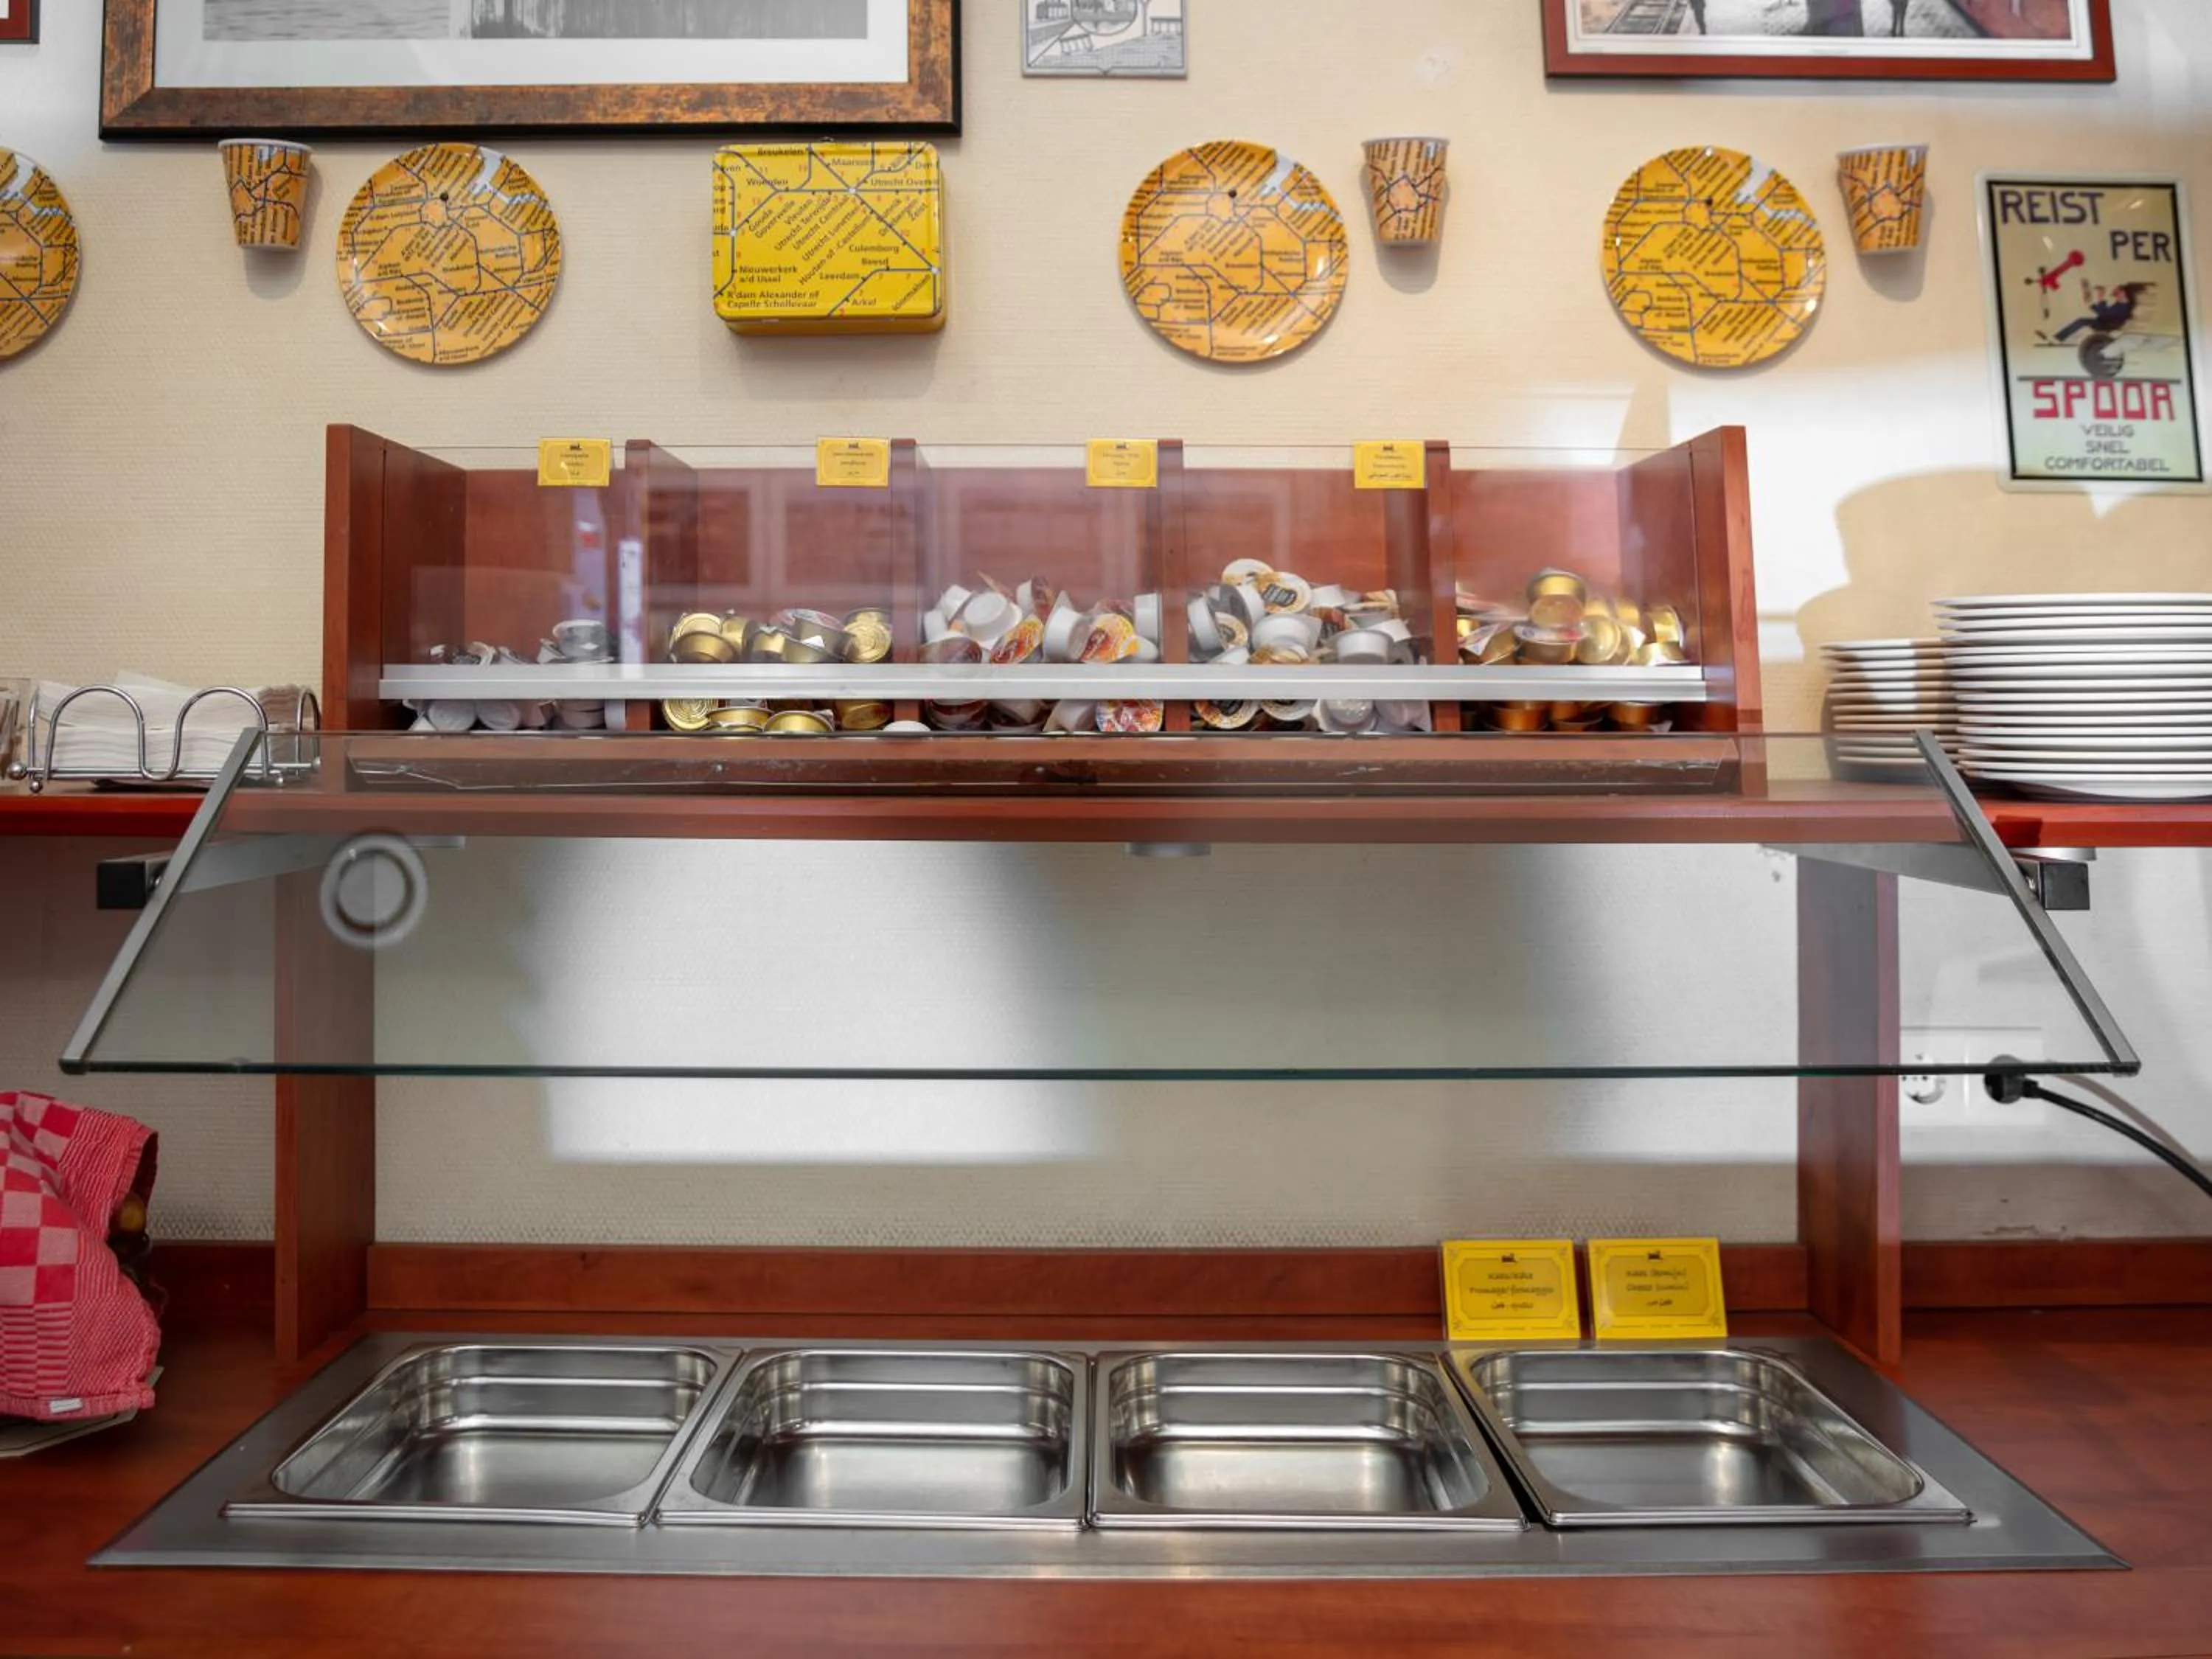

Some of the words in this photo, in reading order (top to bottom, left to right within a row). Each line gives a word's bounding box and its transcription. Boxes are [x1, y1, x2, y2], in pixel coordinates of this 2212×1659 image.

[2000, 190, 2104, 226] REIST
[2109, 230, 2173, 263] PER
[740, 265, 798, 274] Nieuwerkerk
[819, 272, 860, 280] Leerdam
[759, 291, 807, 299] Alexander
[851, 297, 877, 307] Arkel
[2032, 379, 2175, 421] SPOOR
[2081, 423, 2135, 438] VEILIG
[2085, 440, 2130, 455] SNEL
[2044, 456, 2171, 473] COMFORTABEL
